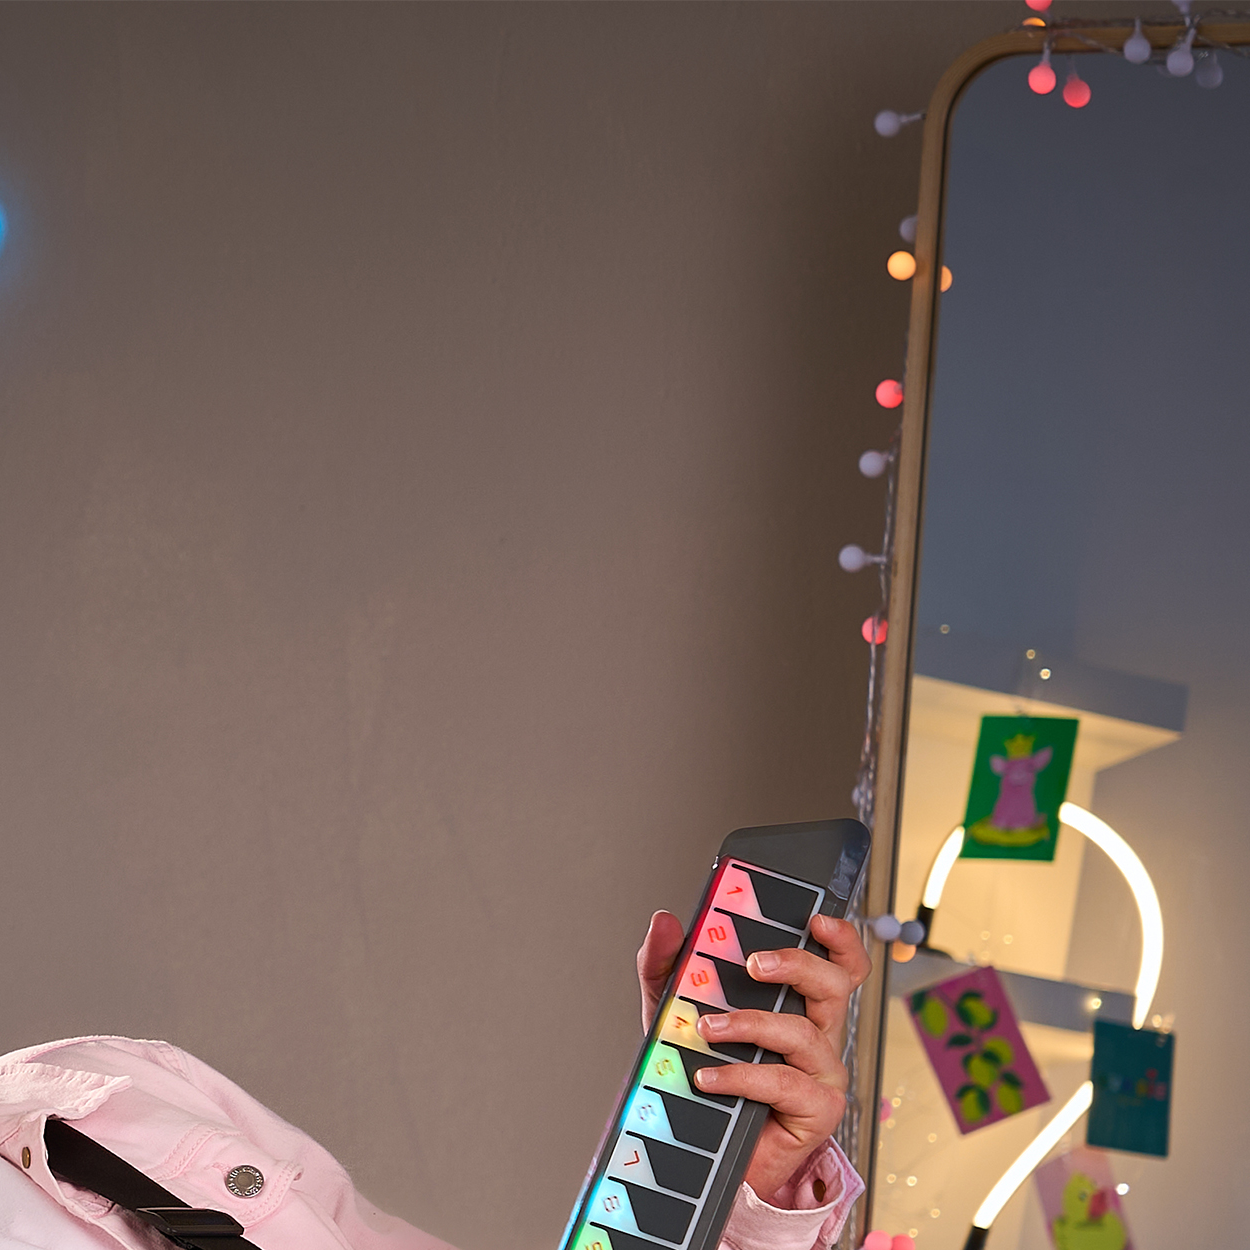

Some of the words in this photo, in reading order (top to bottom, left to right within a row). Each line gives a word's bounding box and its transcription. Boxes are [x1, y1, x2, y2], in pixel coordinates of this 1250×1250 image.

[727, 886, 743, 897] 1
[708, 925, 727, 944] 2
[691, 969, 709, 987] 3
[655, 1059, 675, 1076] 5
[623, 1150, 640, 1166] 7
[603, 1196, 620, 1212] 8
